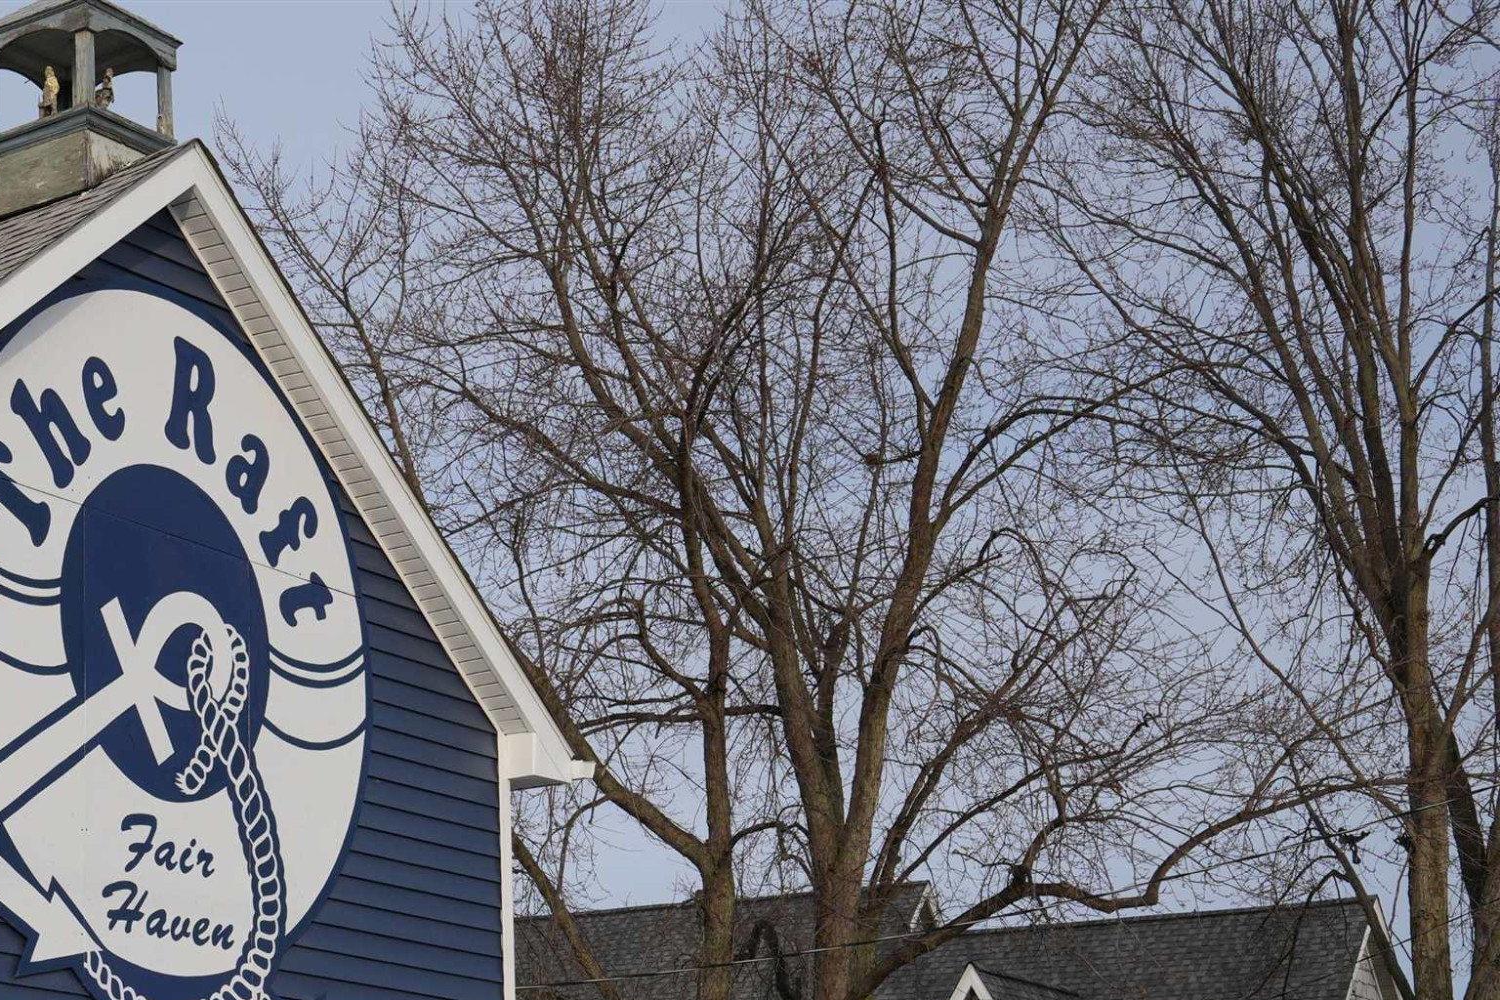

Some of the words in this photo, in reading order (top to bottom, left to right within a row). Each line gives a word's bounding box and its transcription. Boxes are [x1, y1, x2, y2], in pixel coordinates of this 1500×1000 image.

[164, 336, 334, 627] Raft
[120, 813, 215, 878] Fair
[101, 880, 235, 950] Haven
